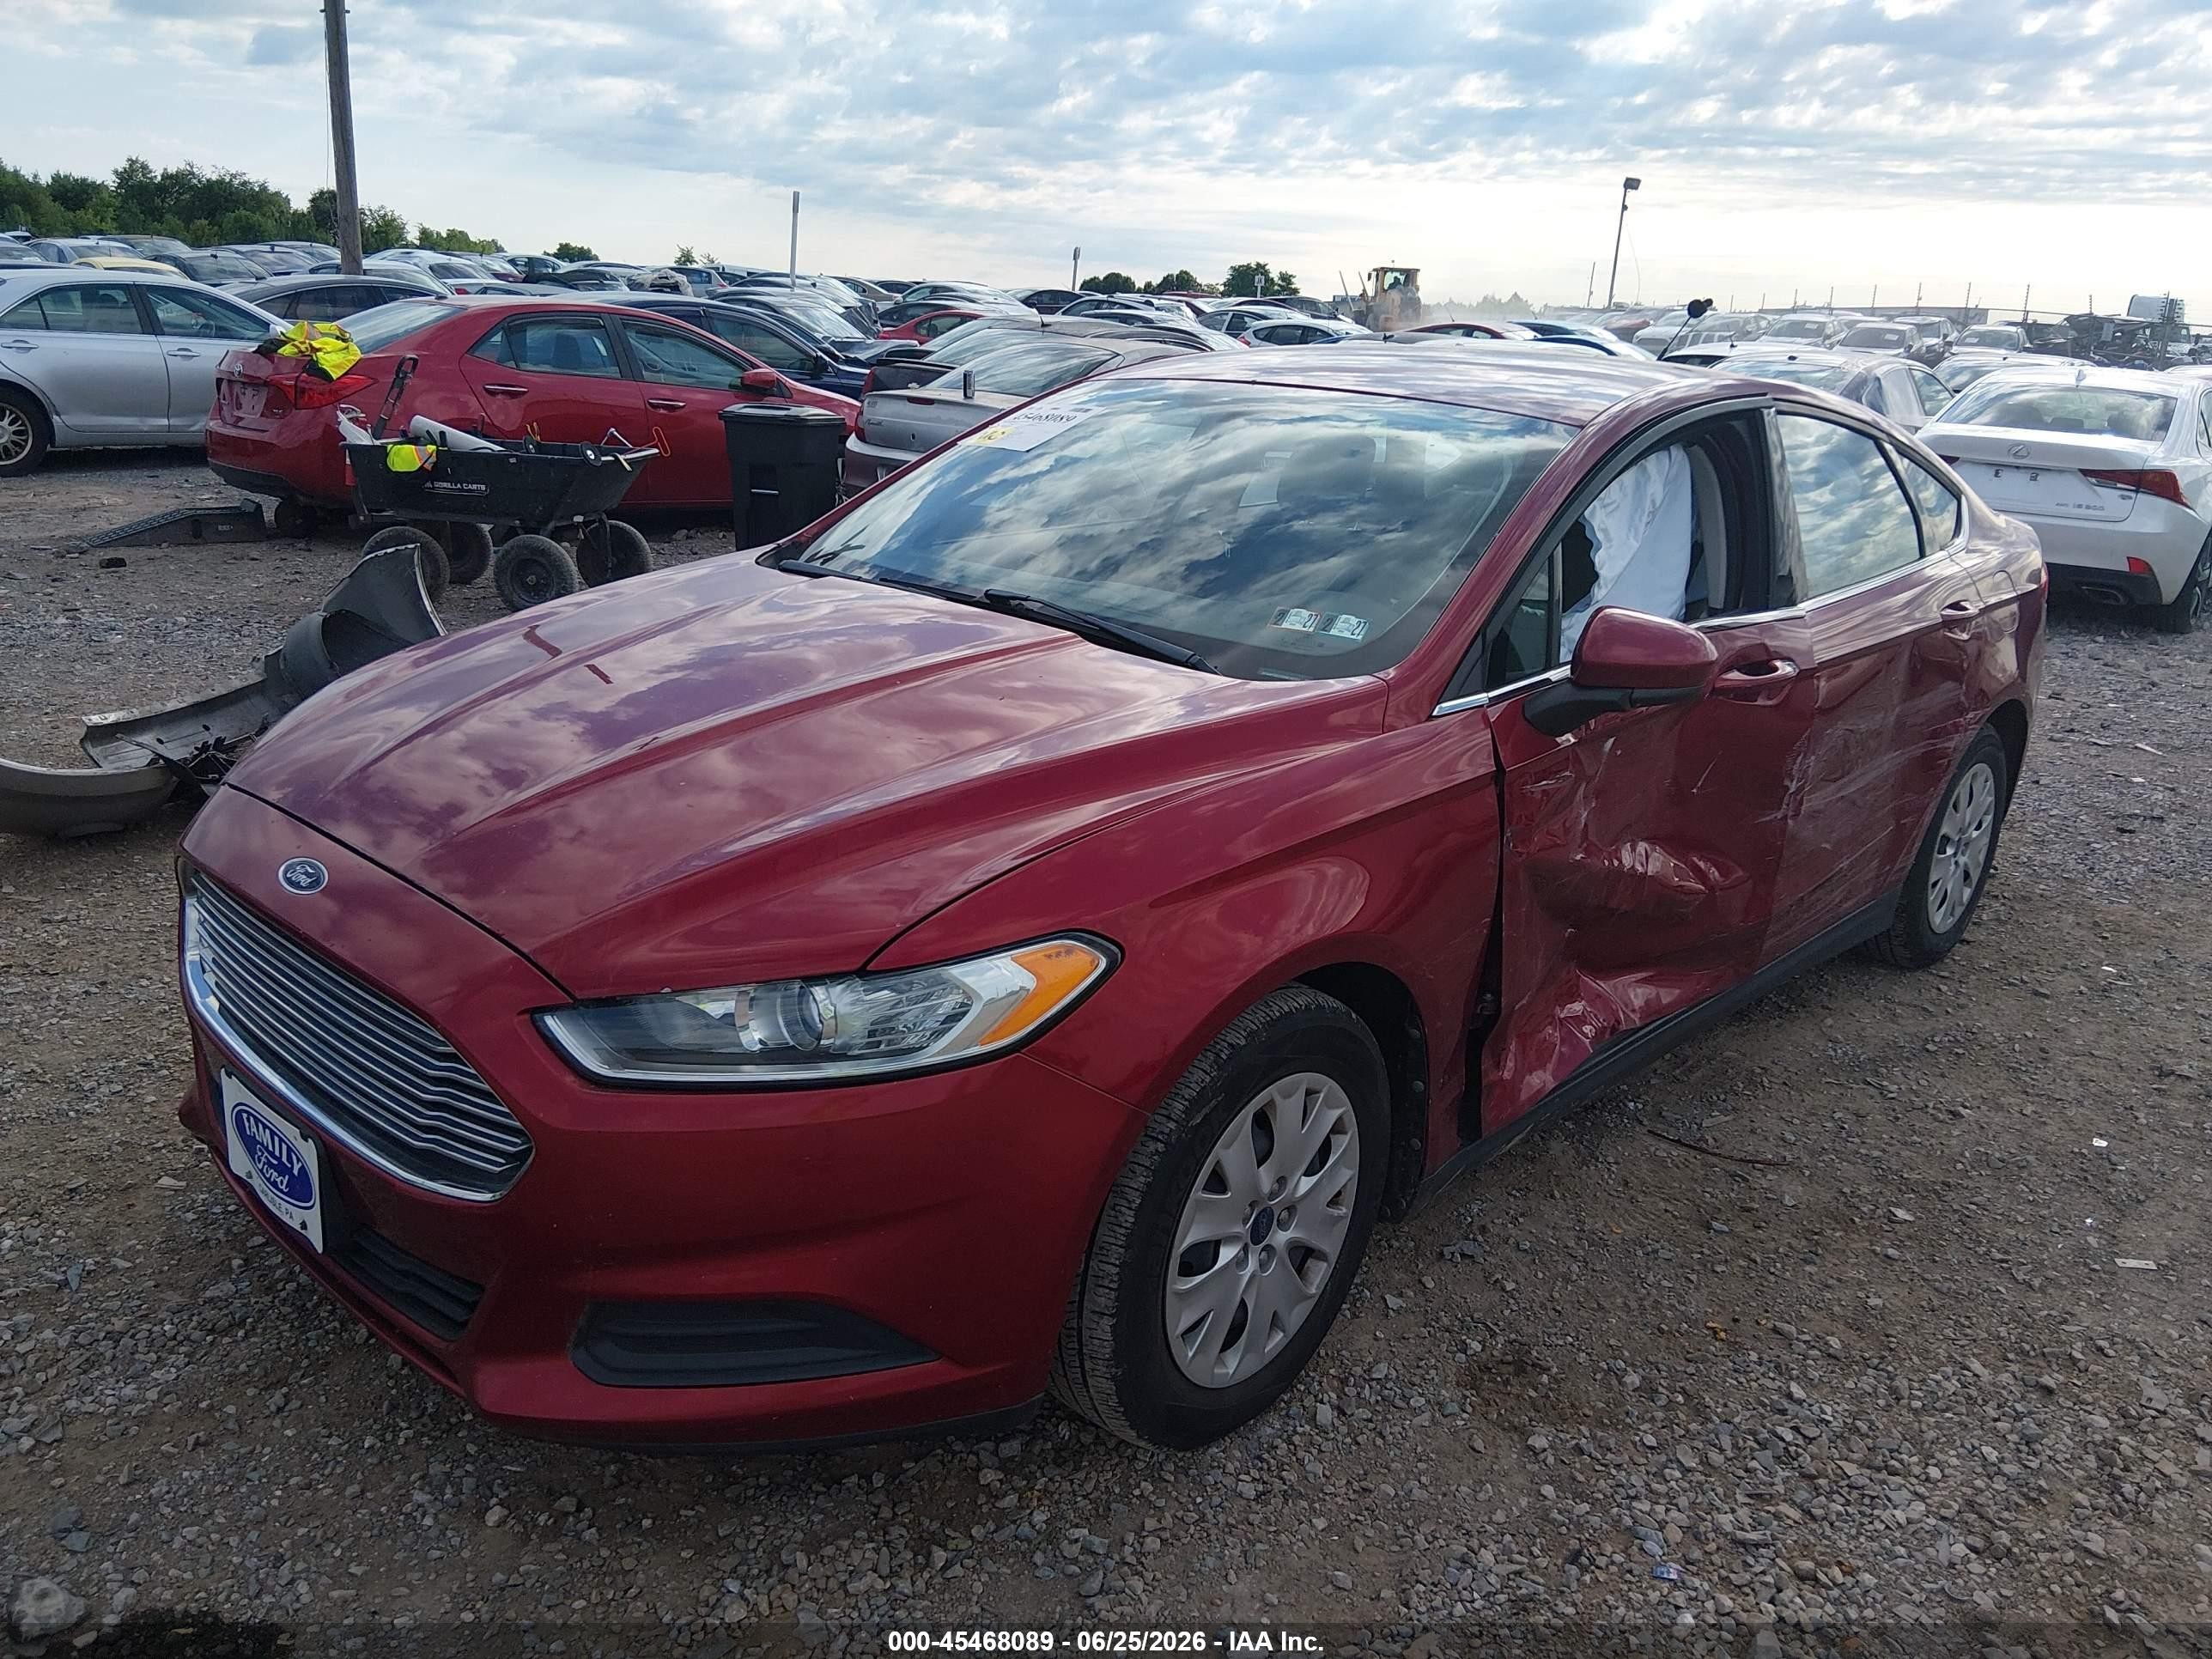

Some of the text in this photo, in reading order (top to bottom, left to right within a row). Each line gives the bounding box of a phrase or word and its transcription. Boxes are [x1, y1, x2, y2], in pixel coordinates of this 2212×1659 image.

[434, 481, 462, 489] GORILLA
[1273, 612, 1285, 626] 2
[1302, 613, 1319, 629] 27
[1321, 617, 1334, 632] 2
[1350, 620, 1368, 637] 27
[286, 864, 318, 887] Ford
[242, 1112, 302, 1177] FAMILY
[254, 1144, 289, 1193] Ford
[284, 1207, 295, 1221] PA
